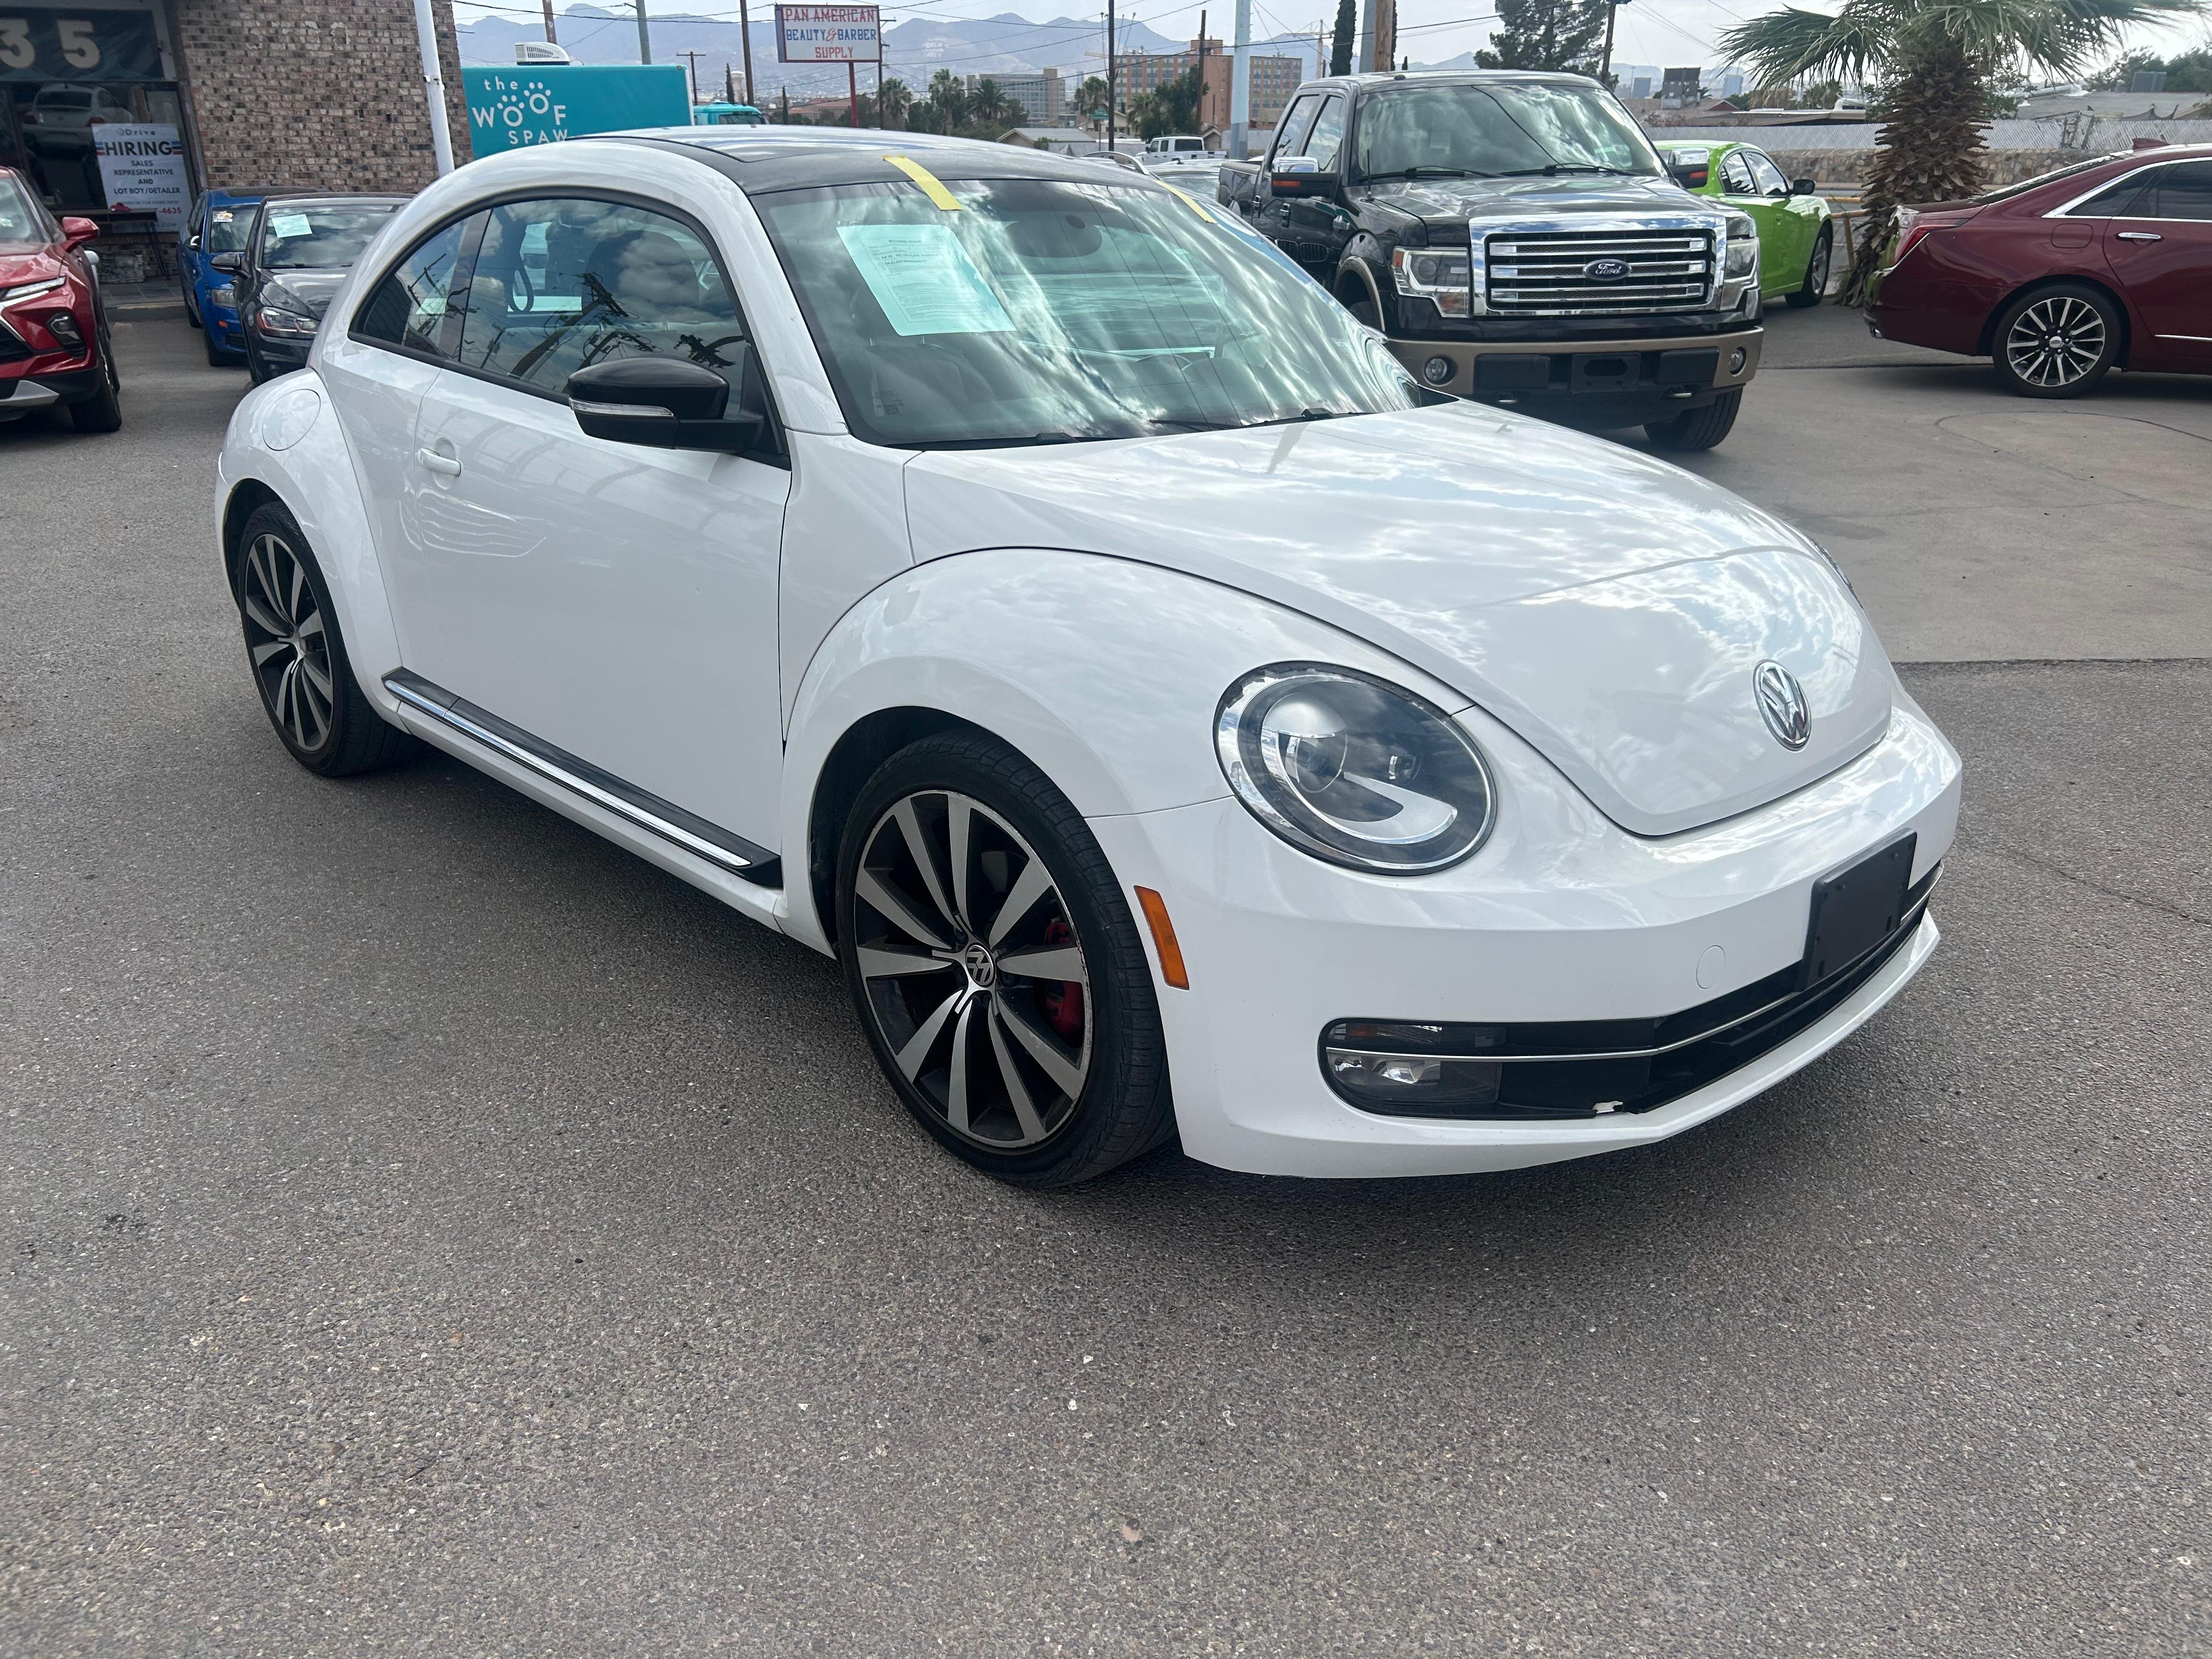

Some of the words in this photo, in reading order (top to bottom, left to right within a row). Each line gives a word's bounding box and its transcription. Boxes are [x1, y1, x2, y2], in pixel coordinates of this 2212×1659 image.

[785, 8, 809, 22] PAN
[814, 8, 874, 22] AMERICAN
[786, 29, 826, 41] BEAUTY
[825, 27, 837, 43] &
[838, 29, 877, 41] BARBER
[815, 47, 854, 58] SUPPLY
[484, 76, 518, 91] the
[472, 91, 566, 128] WOOF
[509, 129, 568, 144] SPAW
[104, 141, 173, 156] HIRING
[1595, 263, 1622, 275] Ford
